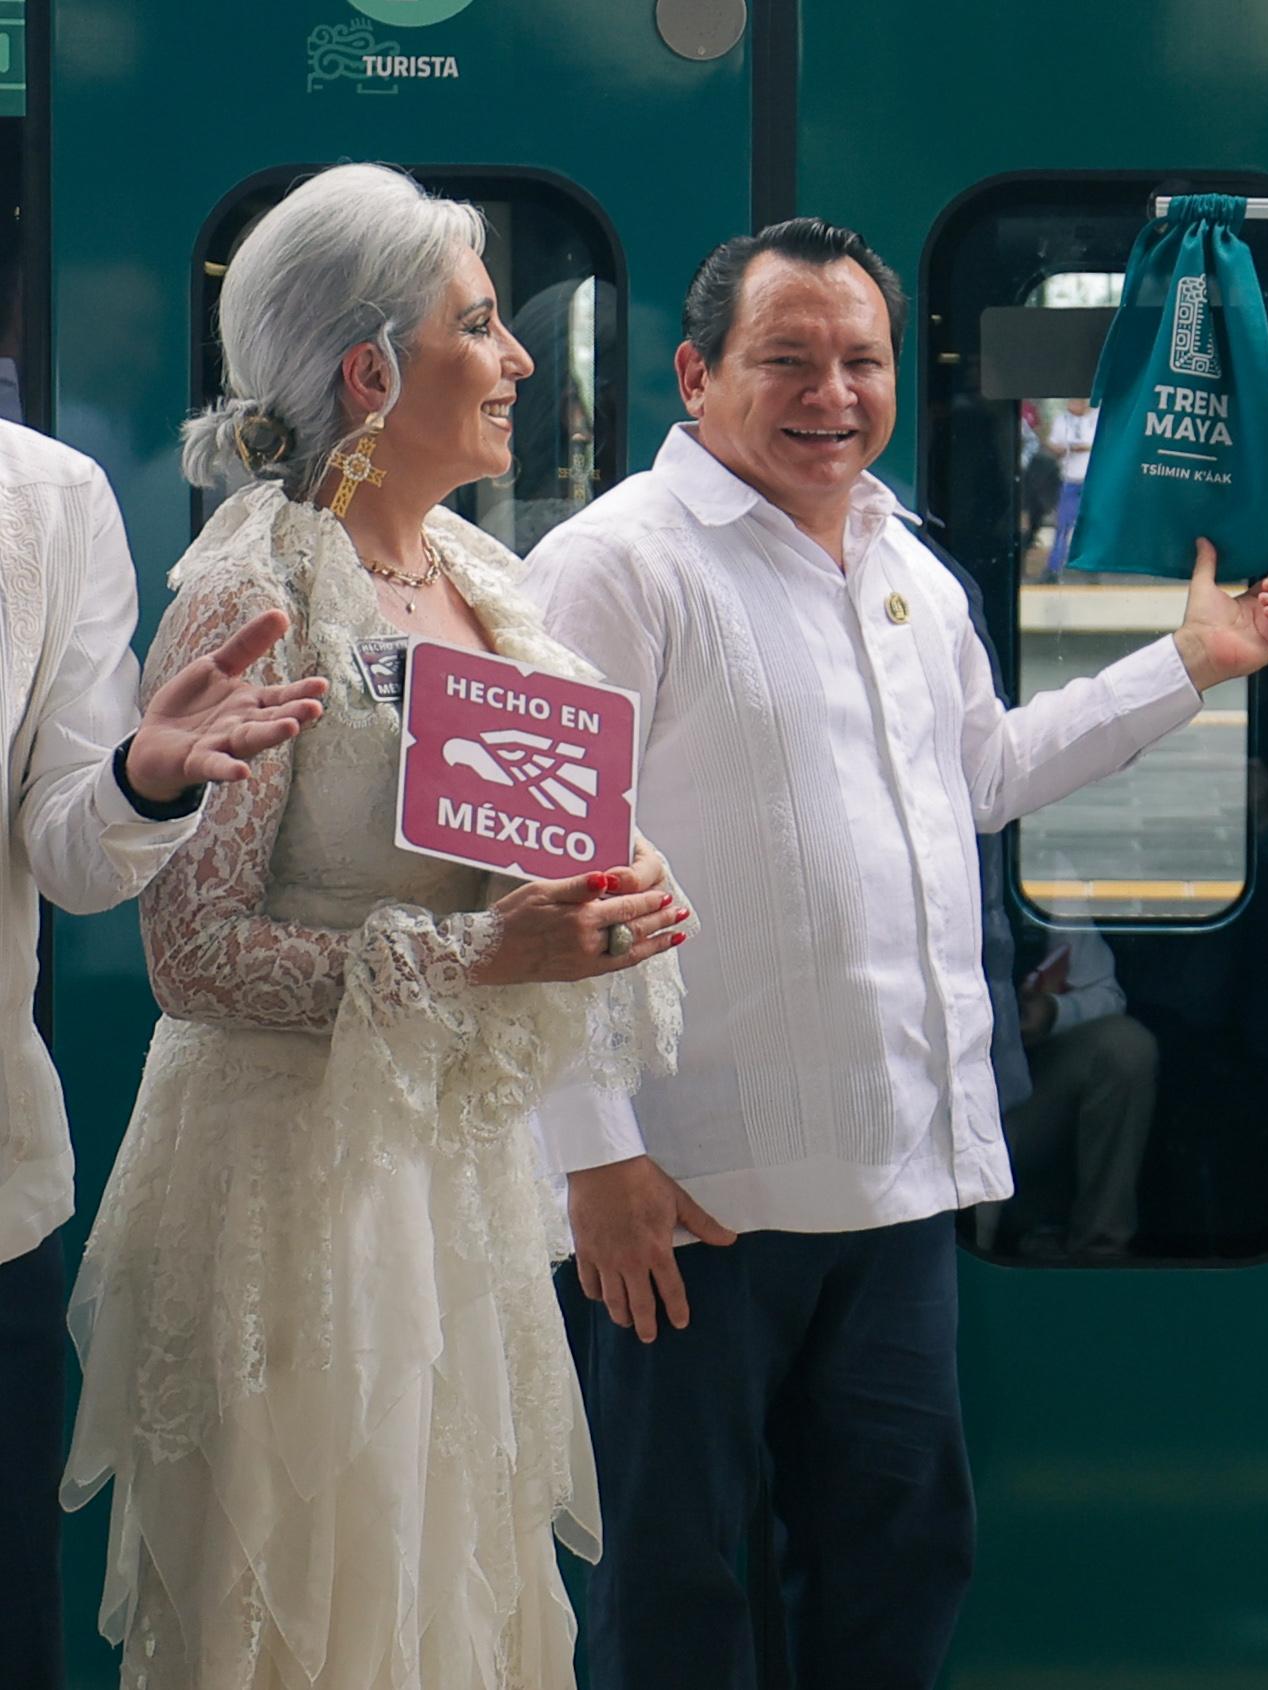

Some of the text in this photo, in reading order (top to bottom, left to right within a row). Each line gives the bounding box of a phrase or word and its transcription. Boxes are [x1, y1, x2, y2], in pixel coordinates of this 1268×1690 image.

[362, 55, 459, 78] TURISTA
[1154, 384, 1229, 418] TREN
[1144, 411, 1233, 446] MAYA
[446, 675, 600, 735] HECHO EN
[437, 796, 596, 862] MÉXICO
